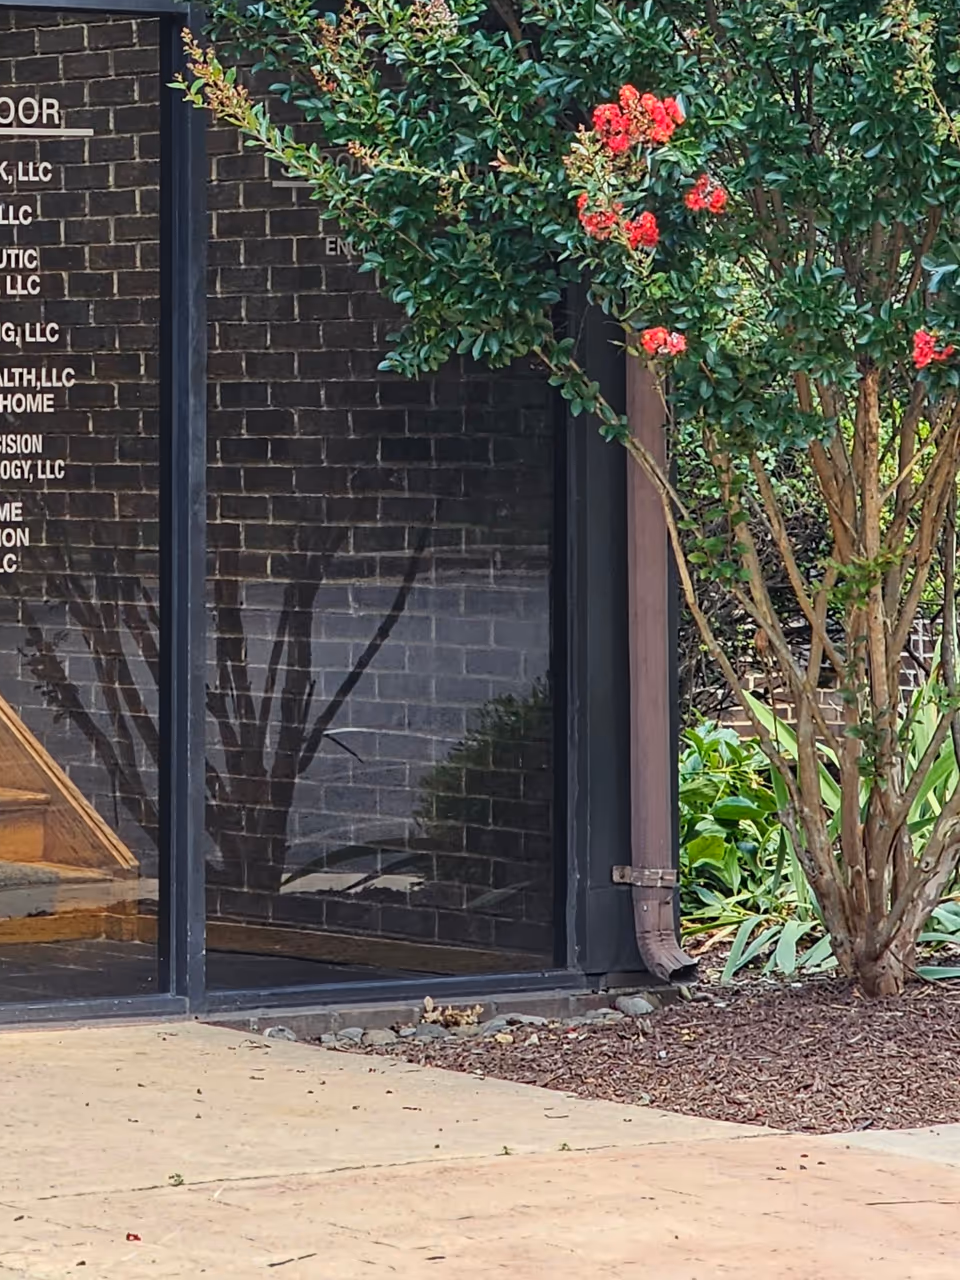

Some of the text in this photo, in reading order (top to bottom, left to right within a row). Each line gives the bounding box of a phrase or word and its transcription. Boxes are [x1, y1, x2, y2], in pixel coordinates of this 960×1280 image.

[18, 161, 52, 182] LLC
[6, 275, 41, 295] LLC
[25, 322, 60, 343] LLC
[37, 459, 65, 479] LLC
